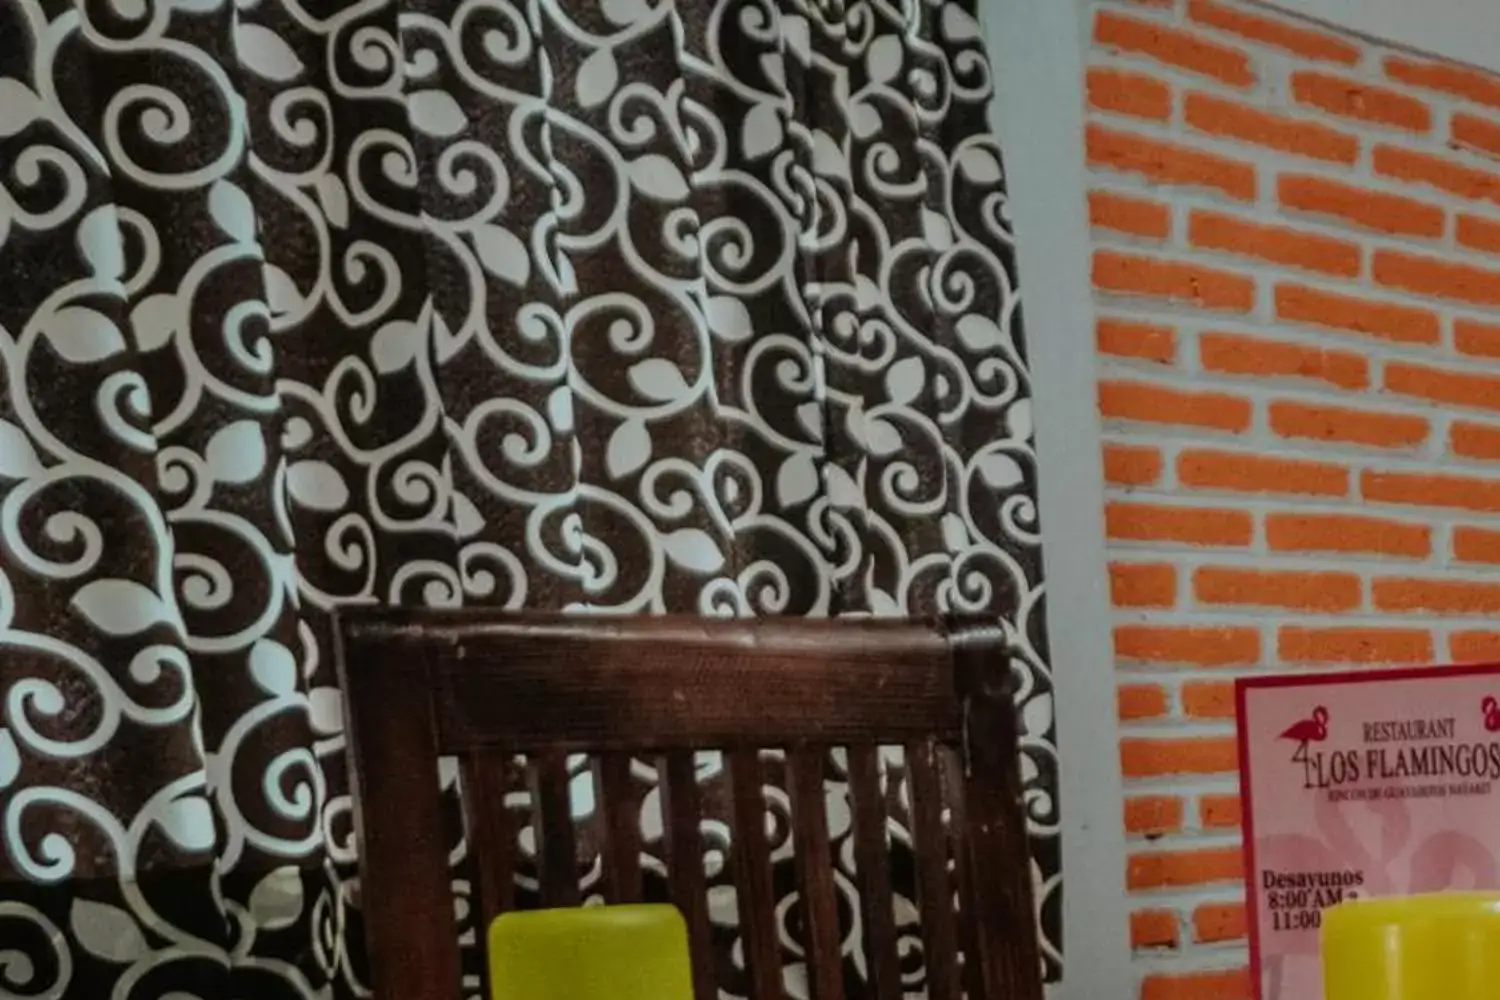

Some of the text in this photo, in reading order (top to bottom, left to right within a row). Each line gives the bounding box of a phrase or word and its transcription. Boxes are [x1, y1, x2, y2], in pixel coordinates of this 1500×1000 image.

[1363, 718, 1456, 742] RESTAURANT
[1317, 750, 1360, 788] LOS
[1262, 869, 1364, 891] Desayunos
[1268, 889, 1308, 910] 8:00
[1312, 887, 1343, 909] AM
[1272, 909, 1322, 931] 11:00
